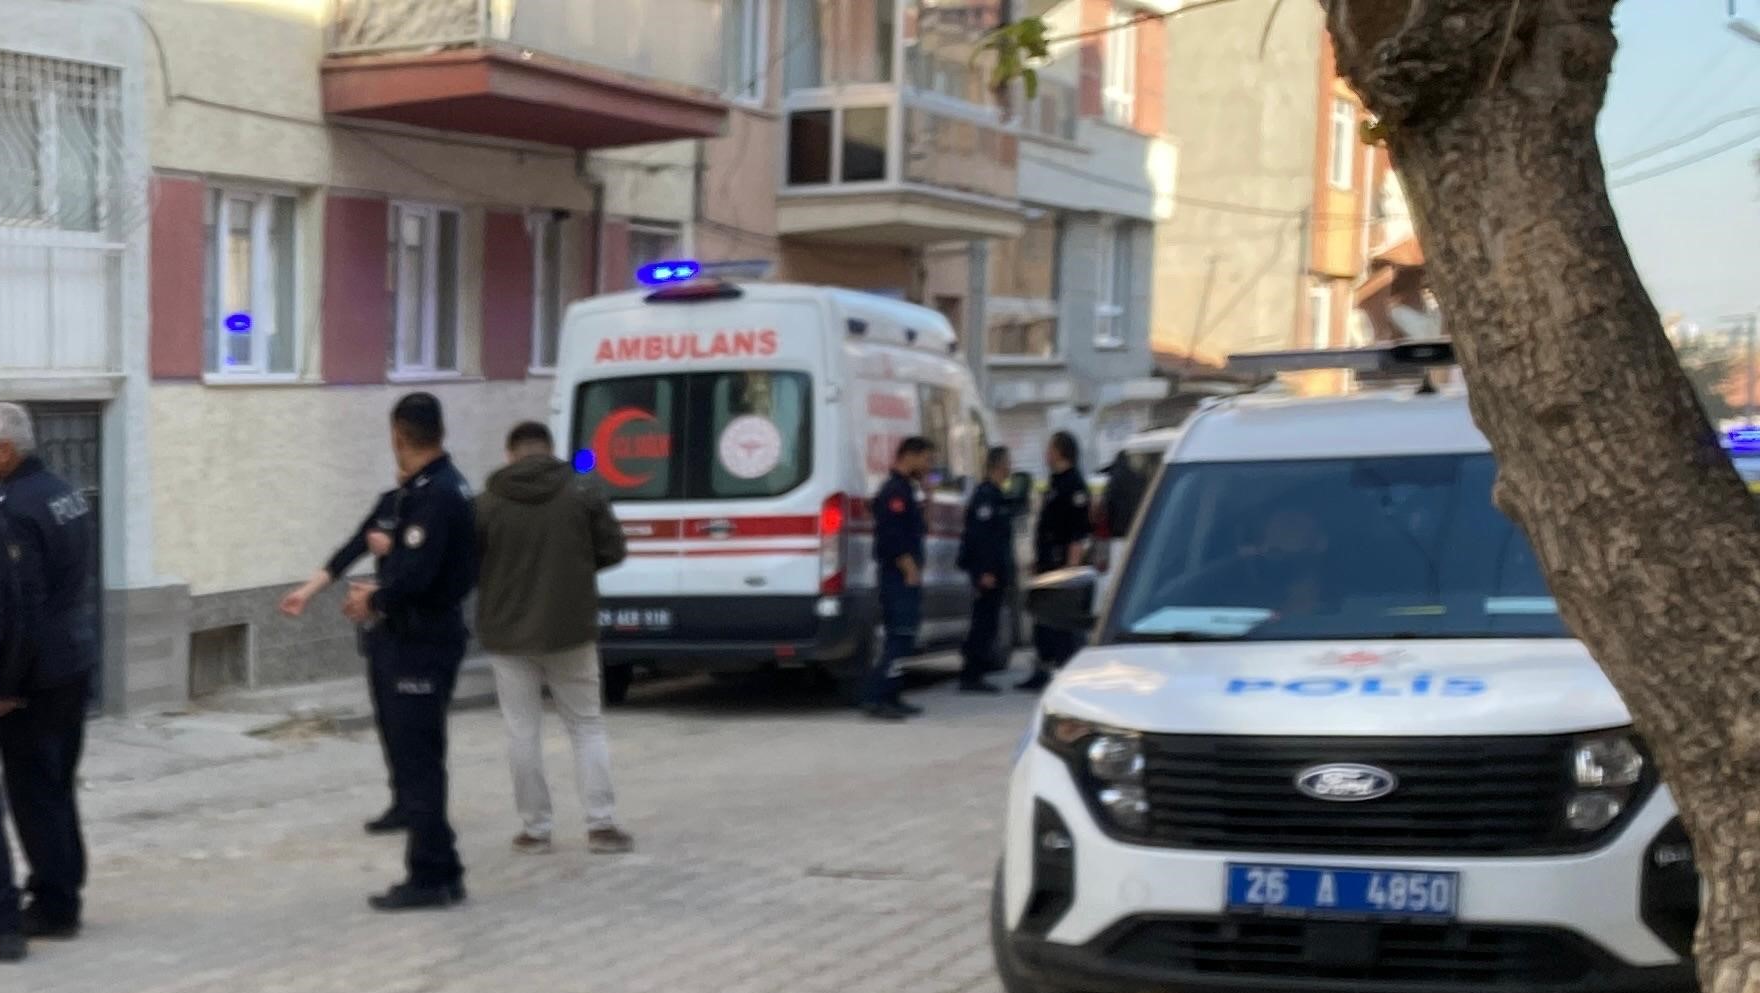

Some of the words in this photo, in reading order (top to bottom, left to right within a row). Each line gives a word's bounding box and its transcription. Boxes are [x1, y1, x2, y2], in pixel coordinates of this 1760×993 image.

[596, 330, 778, 362] AMBULANS
[1246, 870, 1287, 904] 26
[1316, 872, 1336, 906] A
[1368, 873, 1450, 911] 4850
